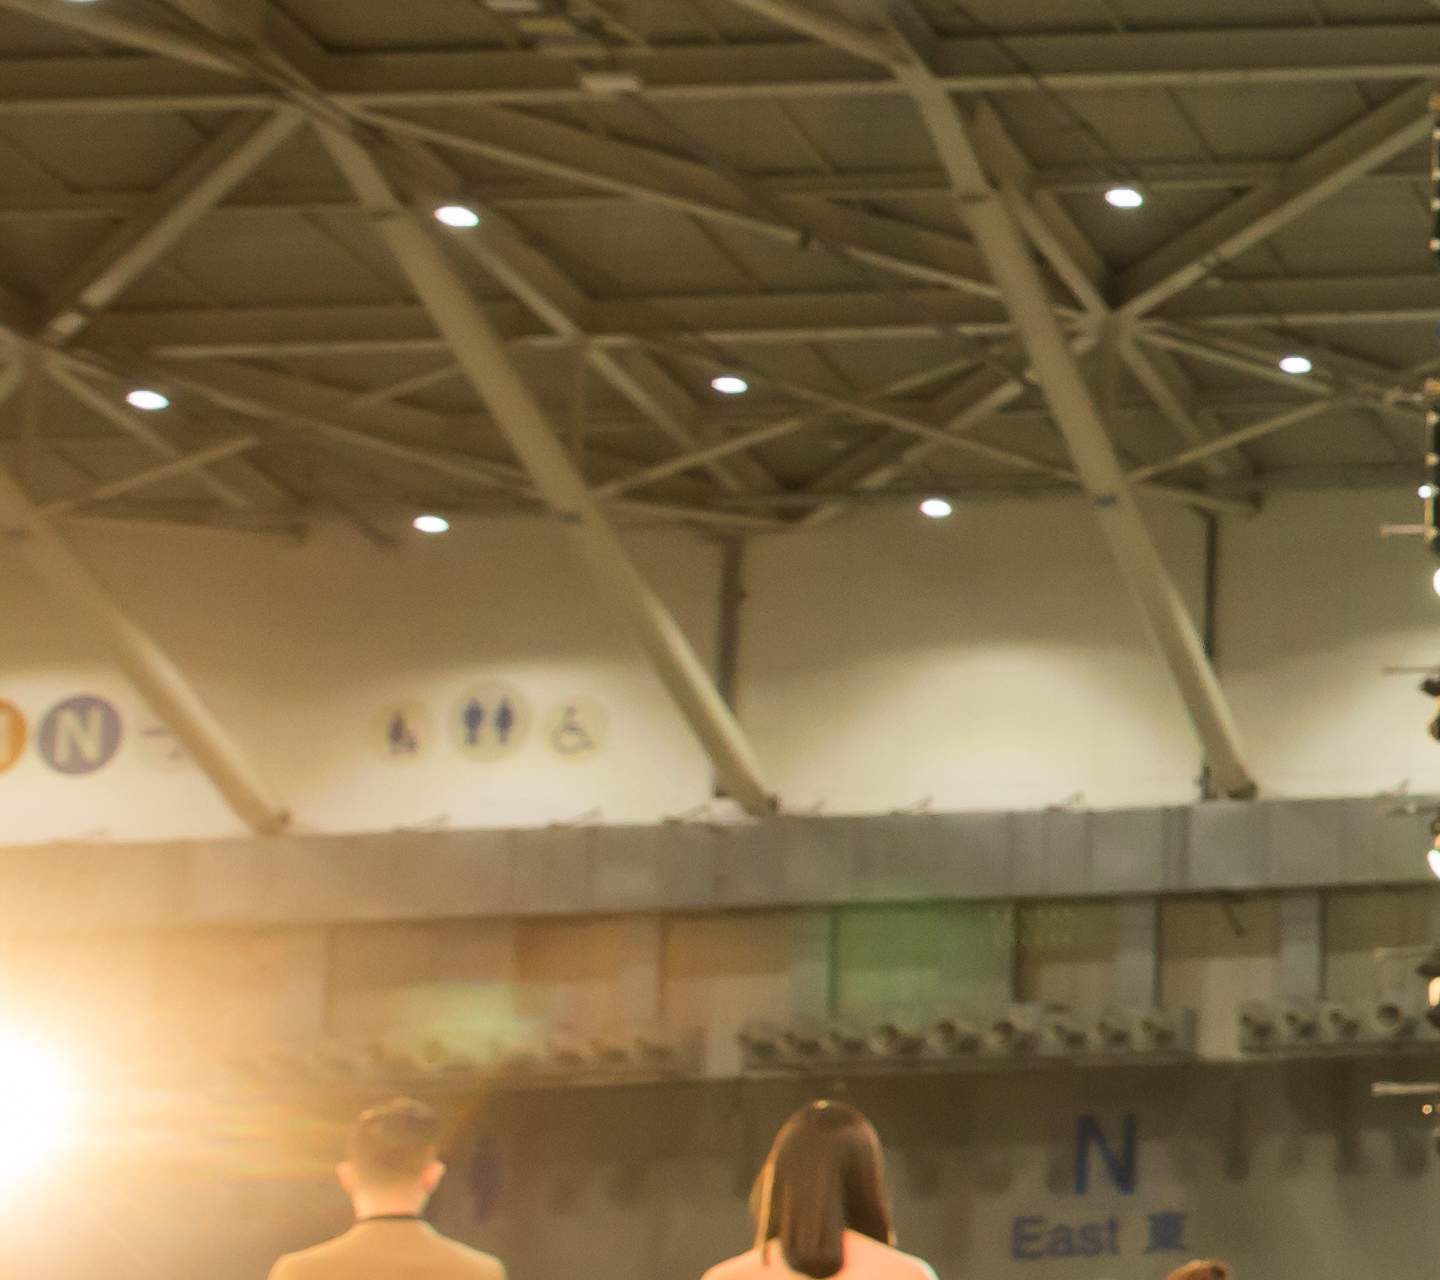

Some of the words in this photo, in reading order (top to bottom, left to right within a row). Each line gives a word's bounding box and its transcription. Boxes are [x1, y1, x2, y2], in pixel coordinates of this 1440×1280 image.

[53, 706, 103, 764] N
[1074, 1112, 1137, 1196] N
[1011, 1215, 1120, 1260] East
